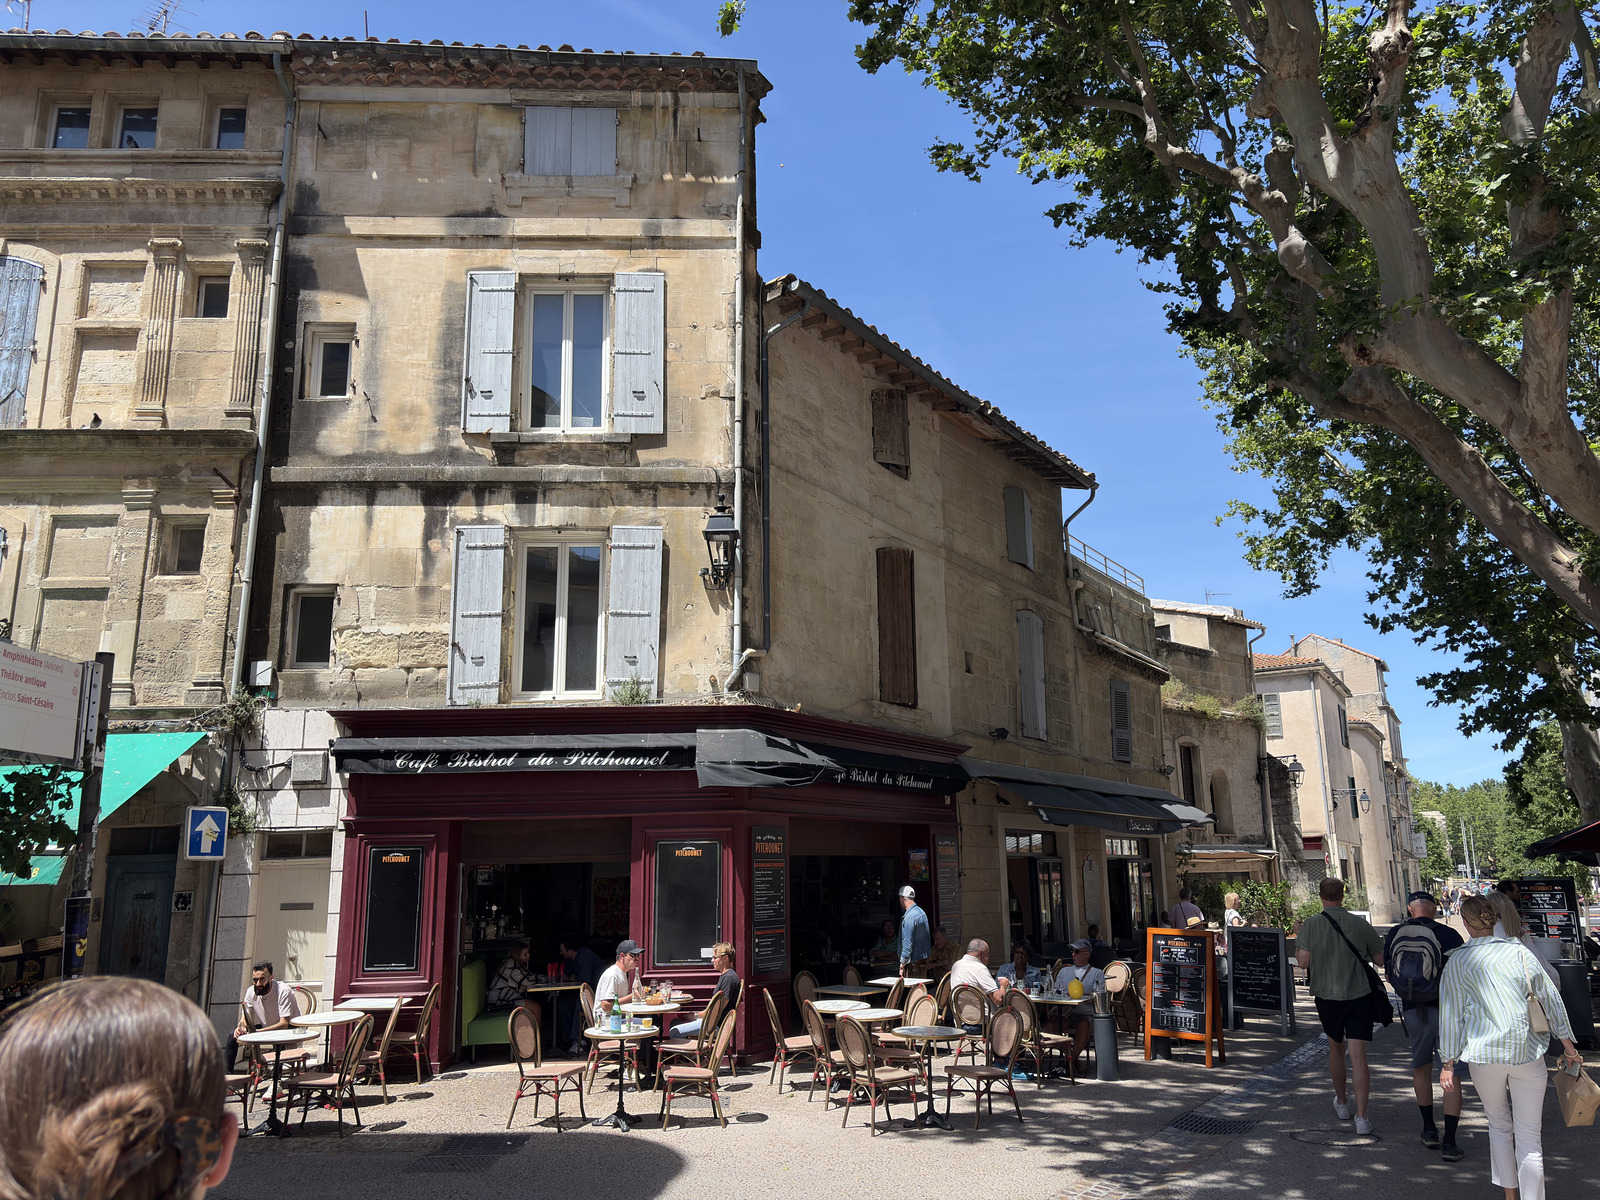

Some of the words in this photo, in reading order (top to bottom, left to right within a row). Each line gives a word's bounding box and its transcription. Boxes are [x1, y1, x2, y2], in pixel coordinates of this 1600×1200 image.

[2, 648, 43, 668] Amphithéâtre
[0, 668, 24, 683] Théâtre
[24, 676, 47, 689] antique
[17, 693, 55, 709] Saint-Césaire
[394, 751, 439, 773] Café
[447, 750, 519, 769] Bistrot
[563, 750, 672, 769] Pitchounet
[849, 767, 878, 784] Bistrot
[882, 773, 893, 785] du
